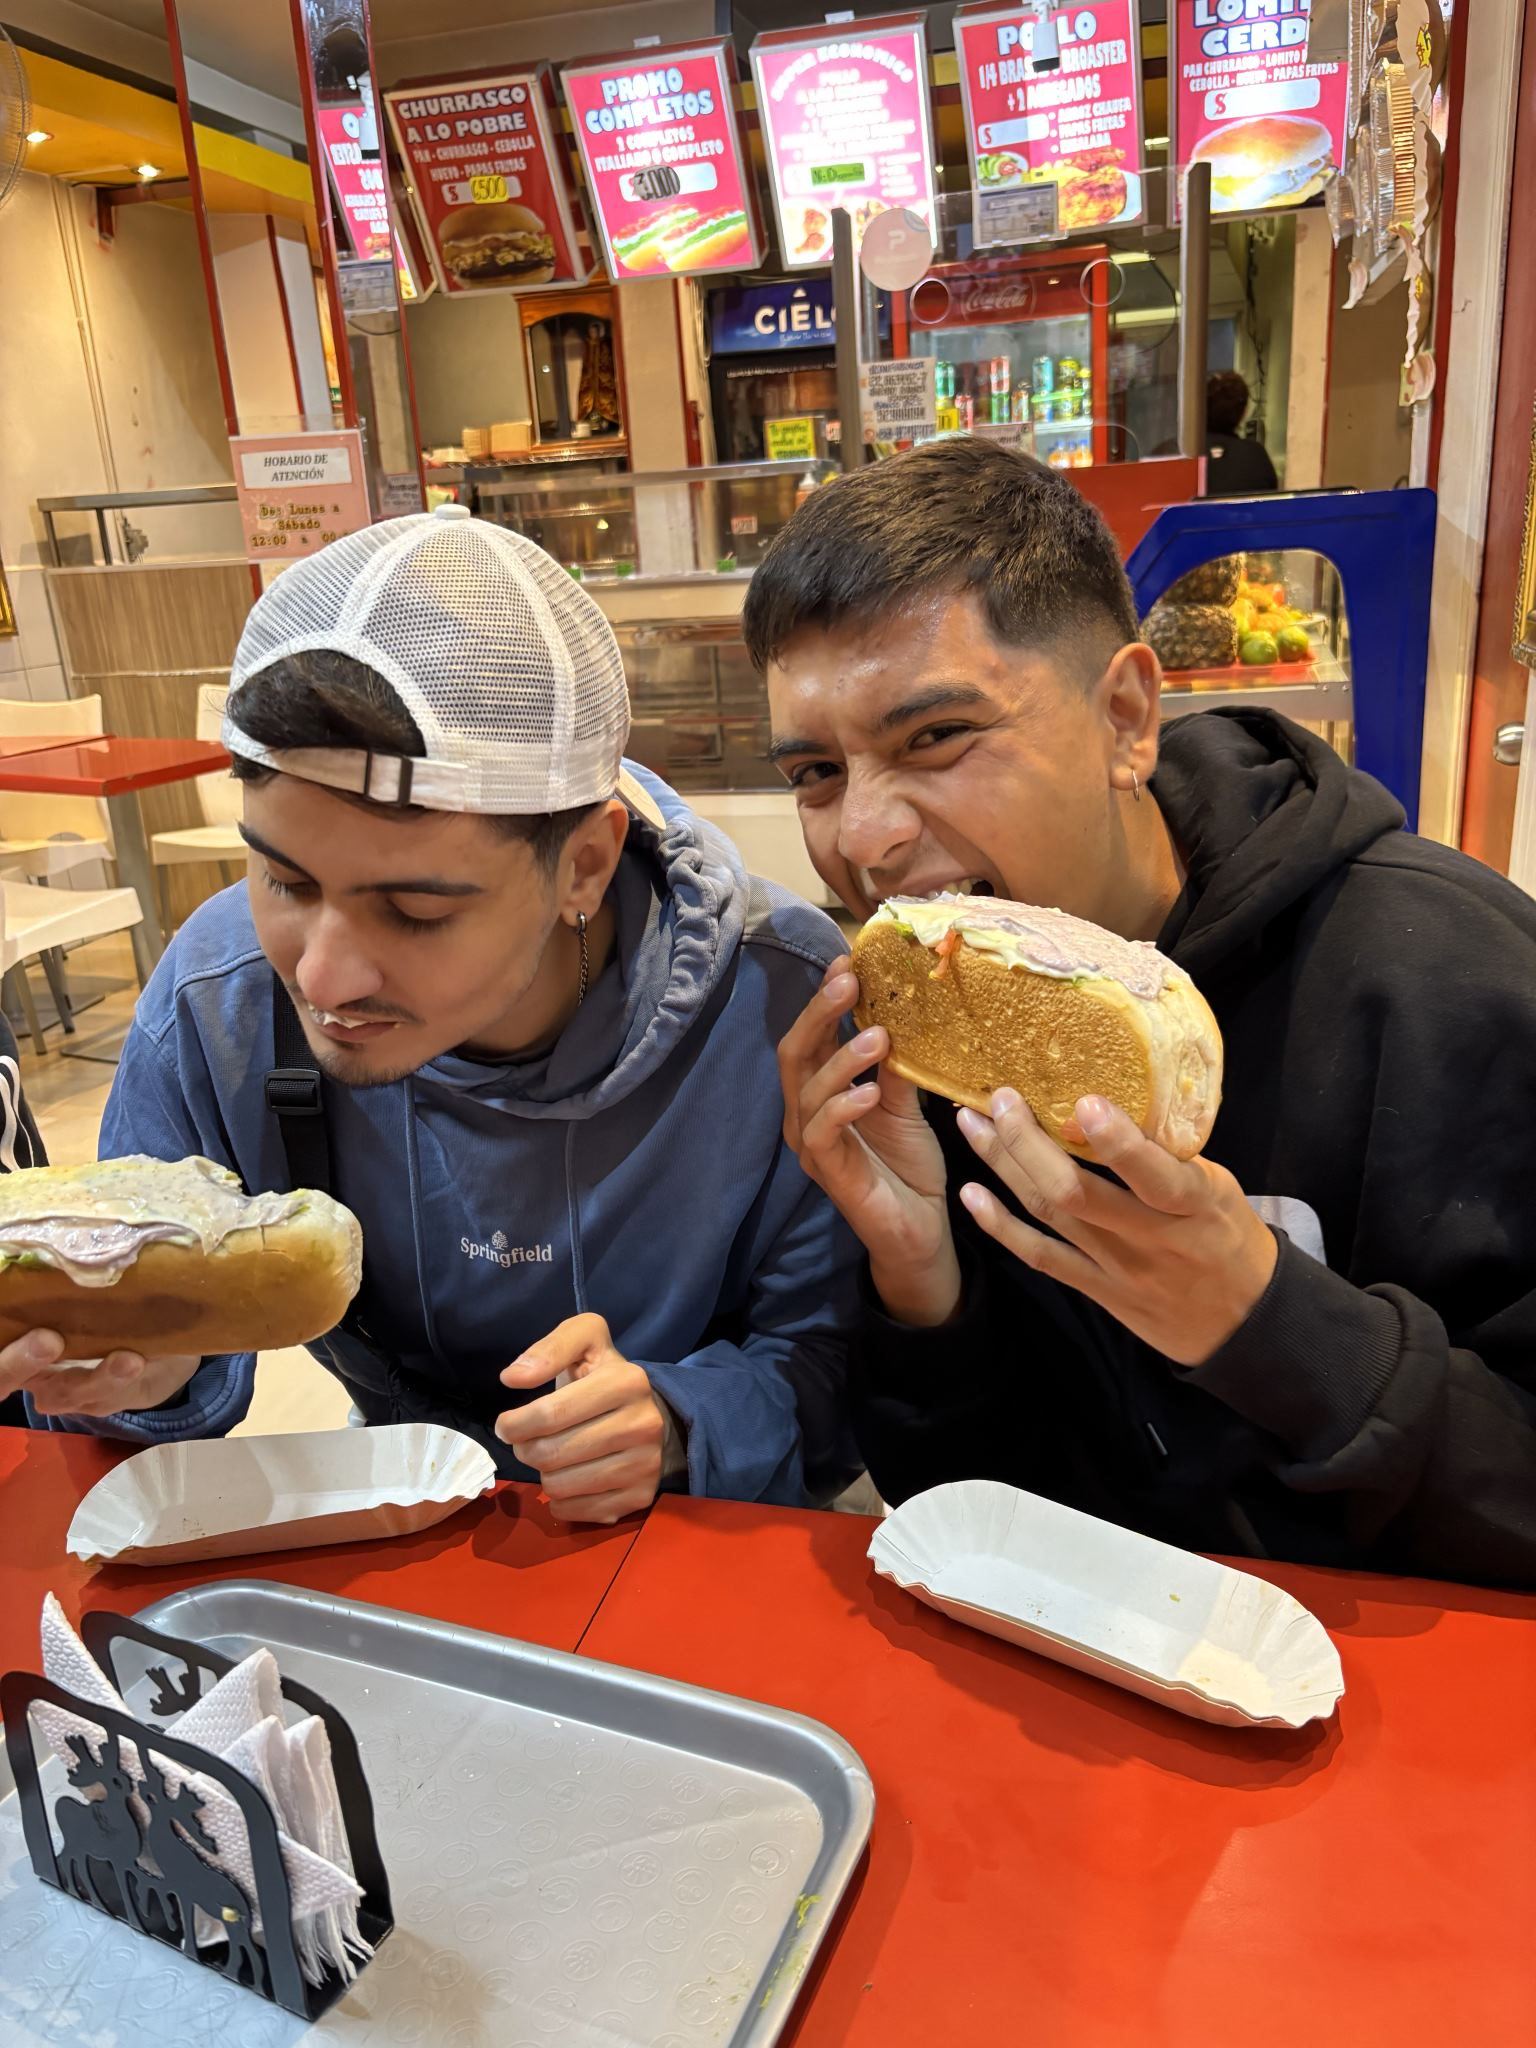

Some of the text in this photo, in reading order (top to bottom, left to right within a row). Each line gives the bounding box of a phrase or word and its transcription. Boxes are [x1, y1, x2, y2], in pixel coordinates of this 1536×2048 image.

[997, 11, 1097, 55] POLO
[1202, 16, 1307, 58] CERD
[978, 63, 997, 90] 1/4
[1183, 64, 1203, 78] PAN
[1204, 55, 1261, 76] CHURRASCO
[1265, 51, 1301, 68] LOMITO
[1189, 75, 1230, 93] CEBOLLA
[1273, 64, 1305, 81] PAPAS
[1305, 62, 1339, 77] FRITAS
[601, 67, 683, 105] PROMO
[398, 86, 526, 119] CHURRASCO
[585, 89, 714, 134] COMPLETOS
[1214, 93, 1227, 116] $
[407, 112, 527, 143] A LO POBRE
[626, 125, 695, 150] COMPLETOS
[494, 135, 536, 153] CEBOLLA
[594, 150, 651, 172] ITALIANO
[662, 139, 724, 162] COMPLETO
[264, 454, 328, 468] HORARIO DE
[271, 468, 325, 482] ATENCIÓN
[290, 503, 325, 515] Lunes
[278, 519, 320, 531] Sábado
[252, 535, 287, 548] 12:00
[461, 1237, 553, 1268] Springfield
